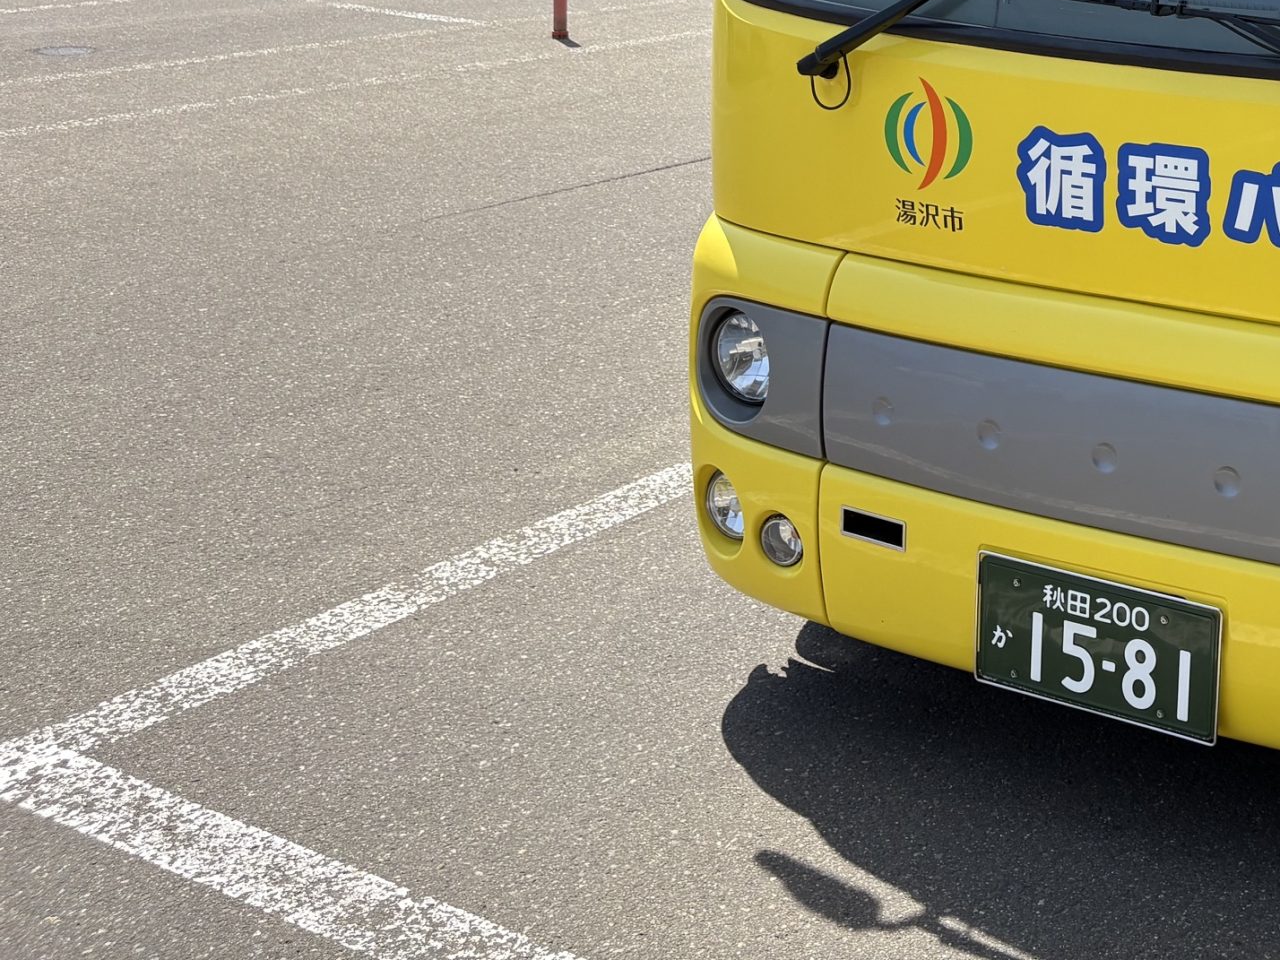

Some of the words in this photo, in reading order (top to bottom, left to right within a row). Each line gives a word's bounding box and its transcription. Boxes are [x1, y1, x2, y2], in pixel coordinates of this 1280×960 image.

[895, 198, 964, 232] 湯沢市
[991, 625, 1014, 649] か
[1030, 611, 1192, 723] 15-81
